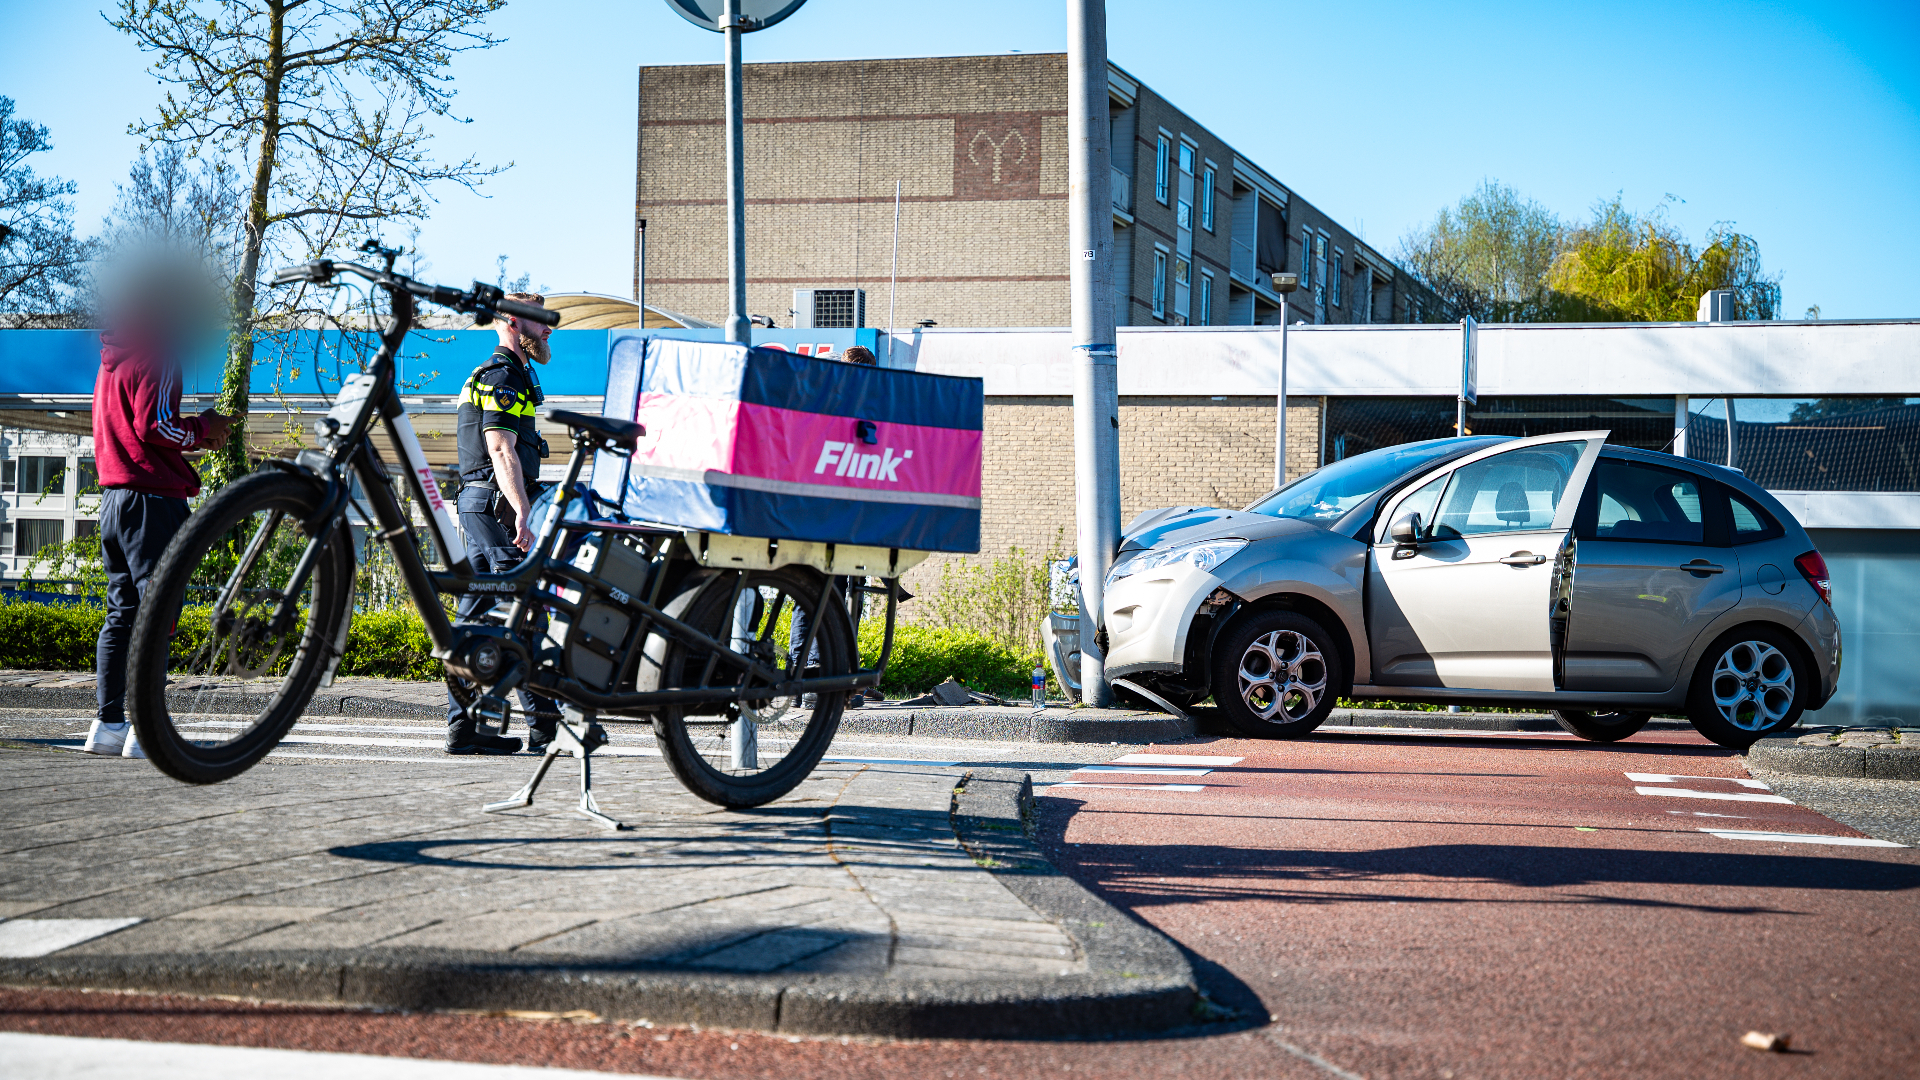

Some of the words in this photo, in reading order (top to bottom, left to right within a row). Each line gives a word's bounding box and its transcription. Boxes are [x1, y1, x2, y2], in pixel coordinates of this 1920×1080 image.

[815, 441, 912, 481] Flink
[417, 467, 446, 512] Flink
[609, 587, 630, 604] 2316
